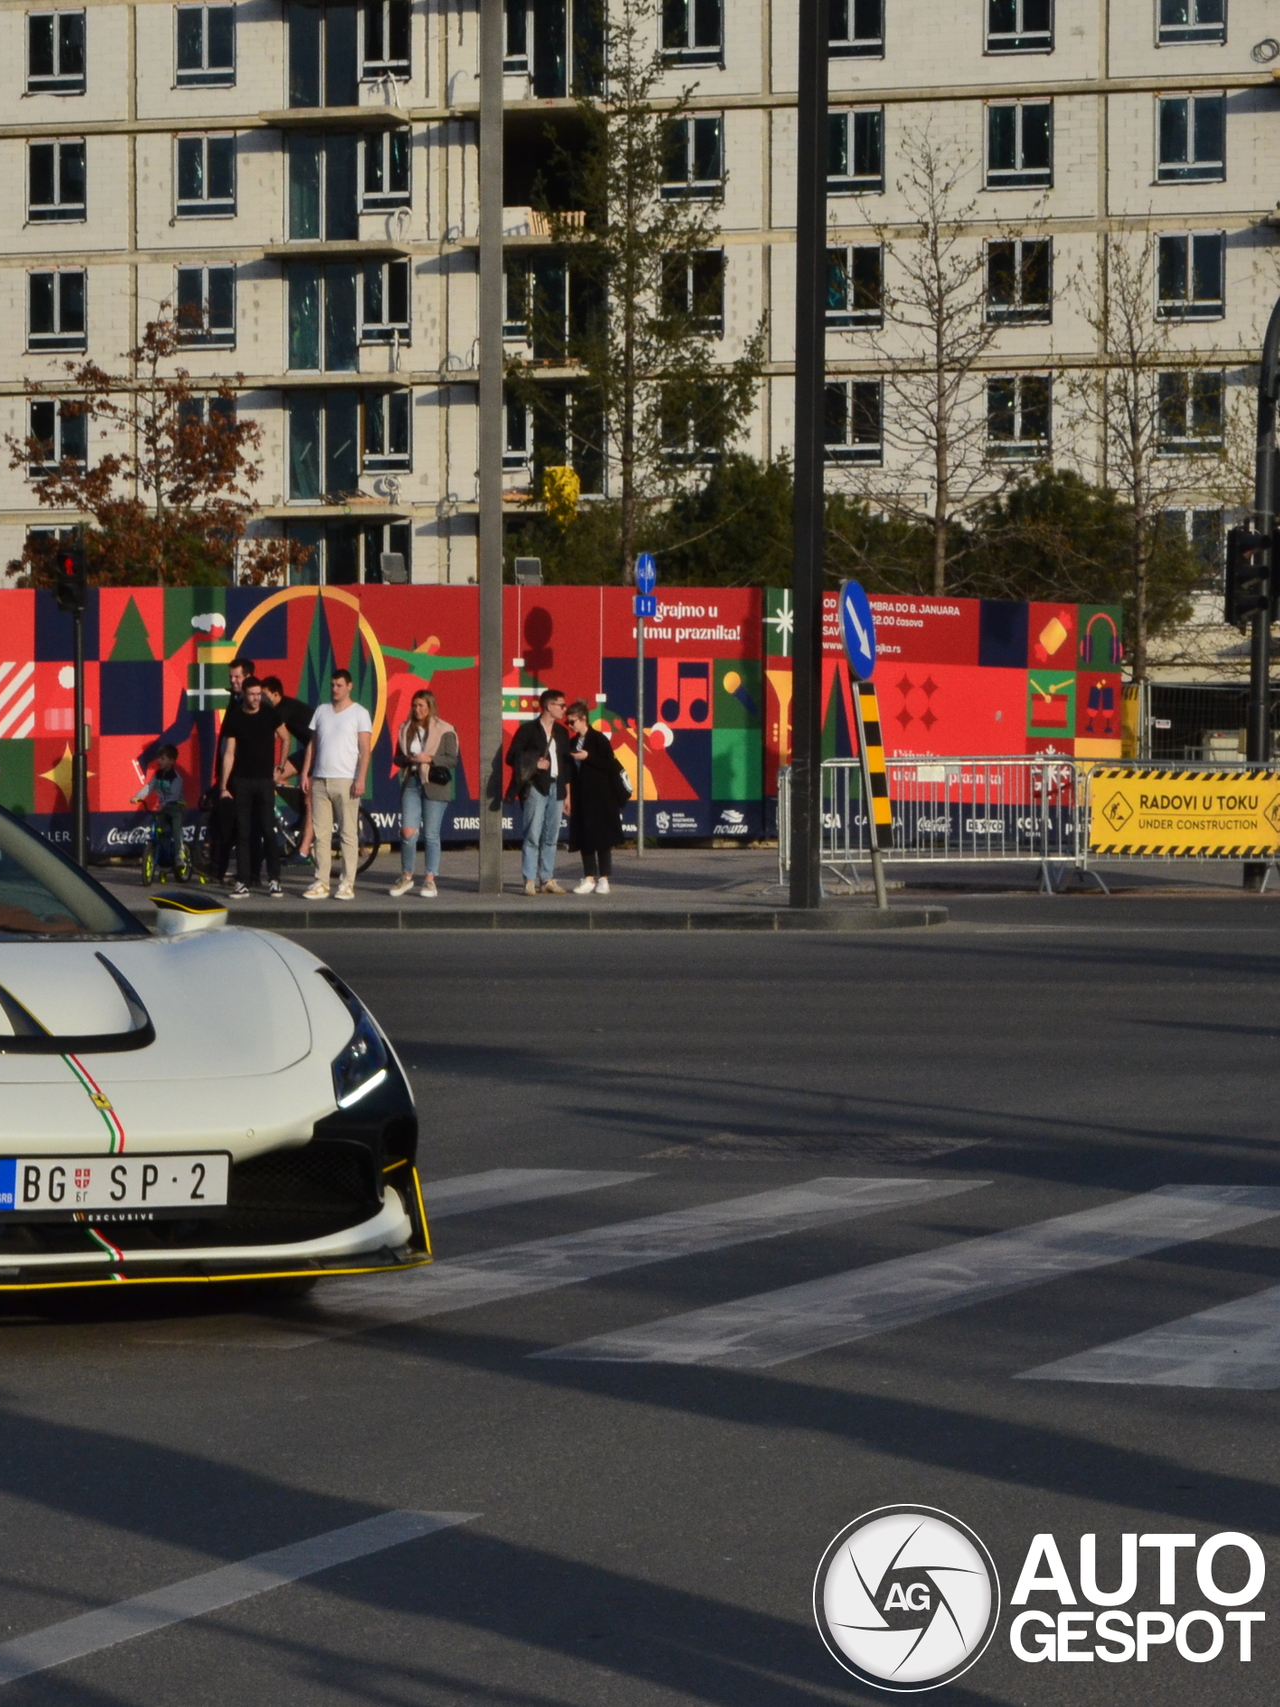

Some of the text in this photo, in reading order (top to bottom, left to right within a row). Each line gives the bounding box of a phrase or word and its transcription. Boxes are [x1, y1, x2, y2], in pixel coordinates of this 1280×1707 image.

[654, 602, 718, 622] grajmo u
[823, 599, 960, 616] OD MBRA DO 8. JANUARA
[822, 613, 834, 622] od
[896, 615, 924, 628] časova
[632, 625, 741, 643] rtmu praznika!
[1140, 794, 1259, 811] RADOVI U TOKU
[1138, 819, 1258, 831] UNDER CONSTRUCTION
[22, 1164, 66, 1203] BG
[75, 1191, 89, 1203] БГ
[87, 1212, 155, 1222] EXCLUSIVE
